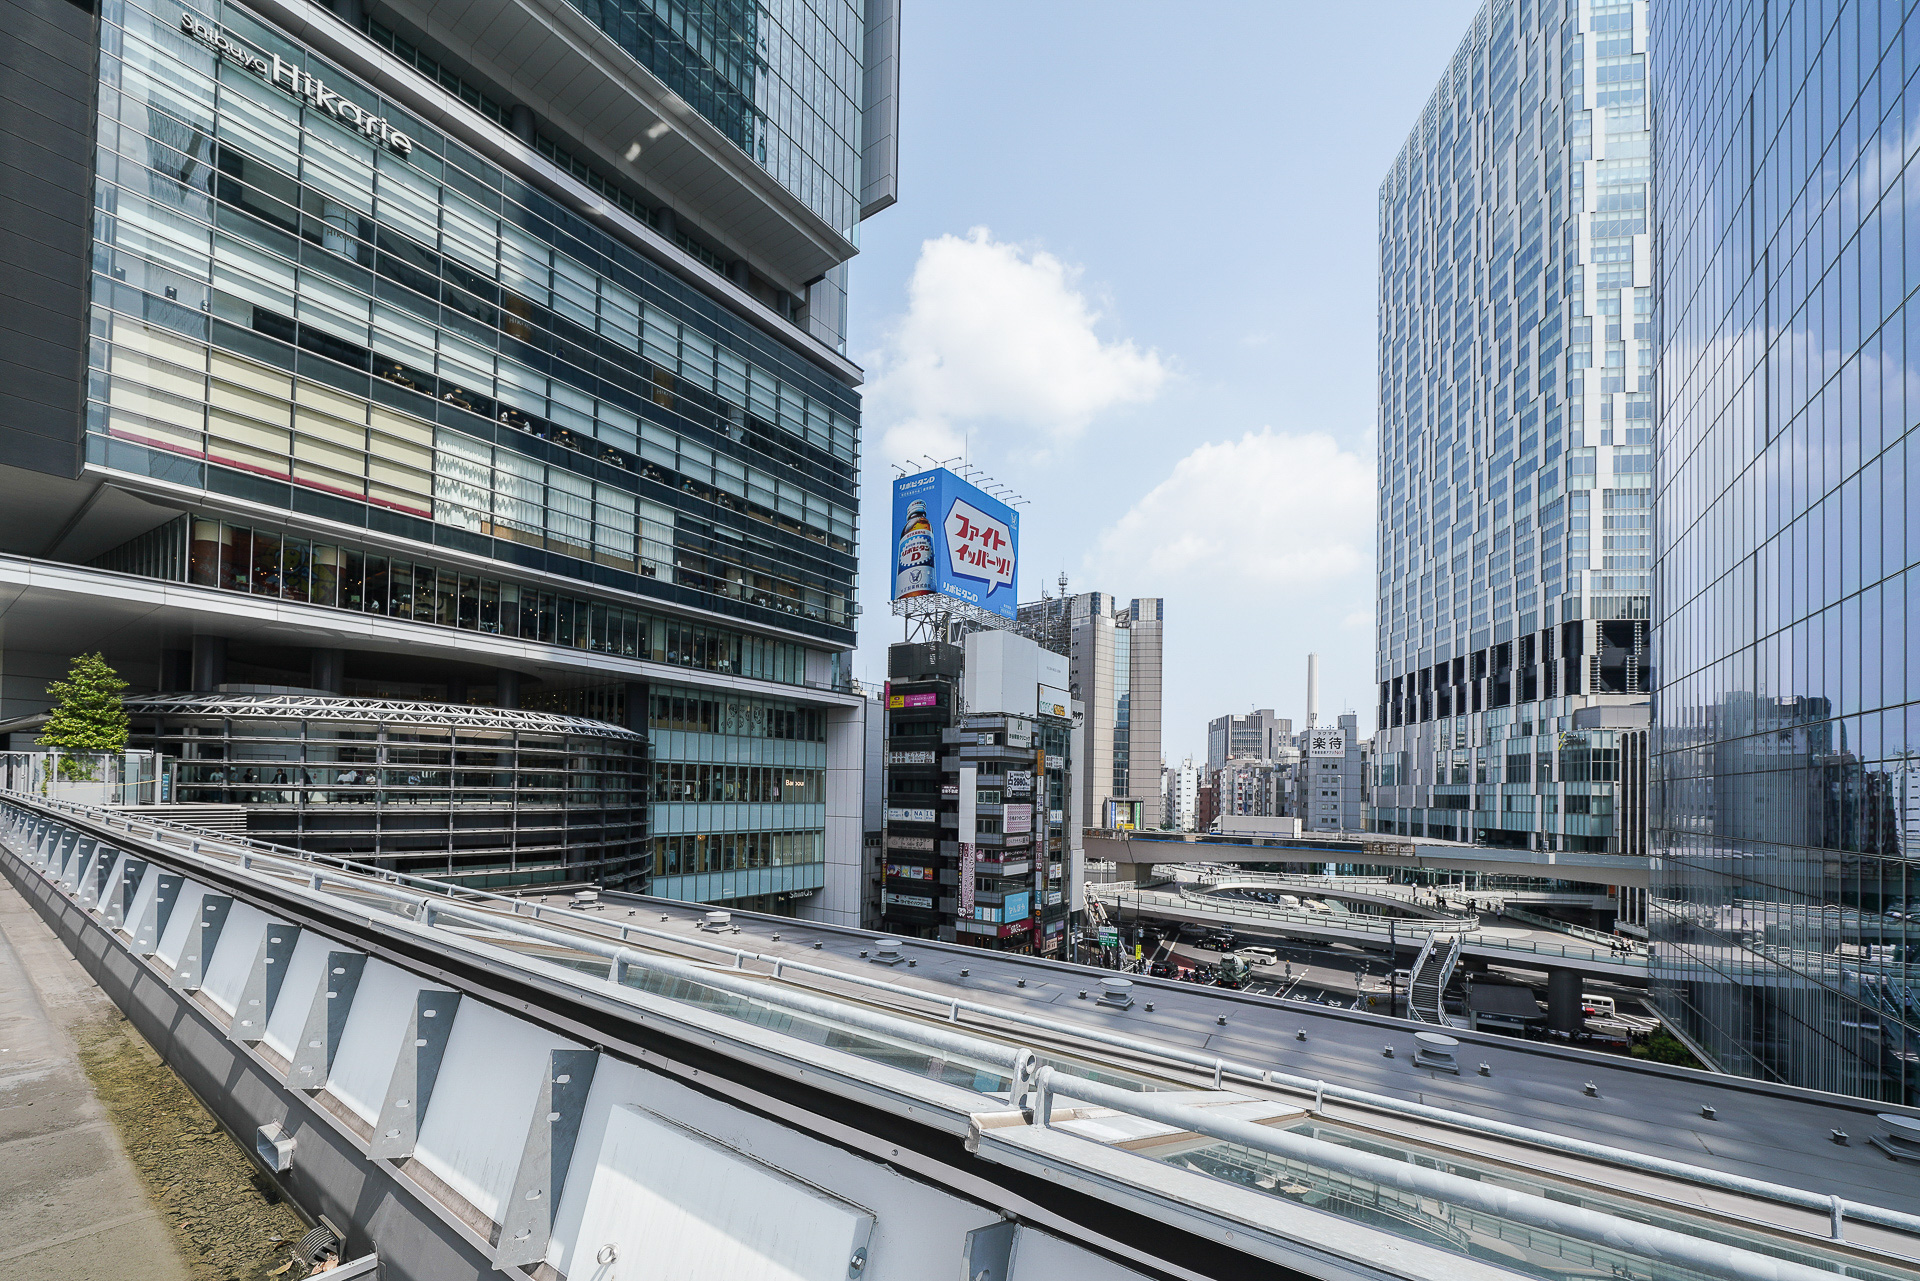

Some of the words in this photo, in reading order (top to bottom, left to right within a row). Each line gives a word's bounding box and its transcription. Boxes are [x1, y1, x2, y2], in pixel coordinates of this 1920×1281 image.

[181, 11, 268, 76] Shibuya
[272, 52, 413, 155] Hikarie
[954, 513, 1007, 551] ファイト
[910, 552, 922, 562] D
[1312, 736, 1343, 750] 楽待
